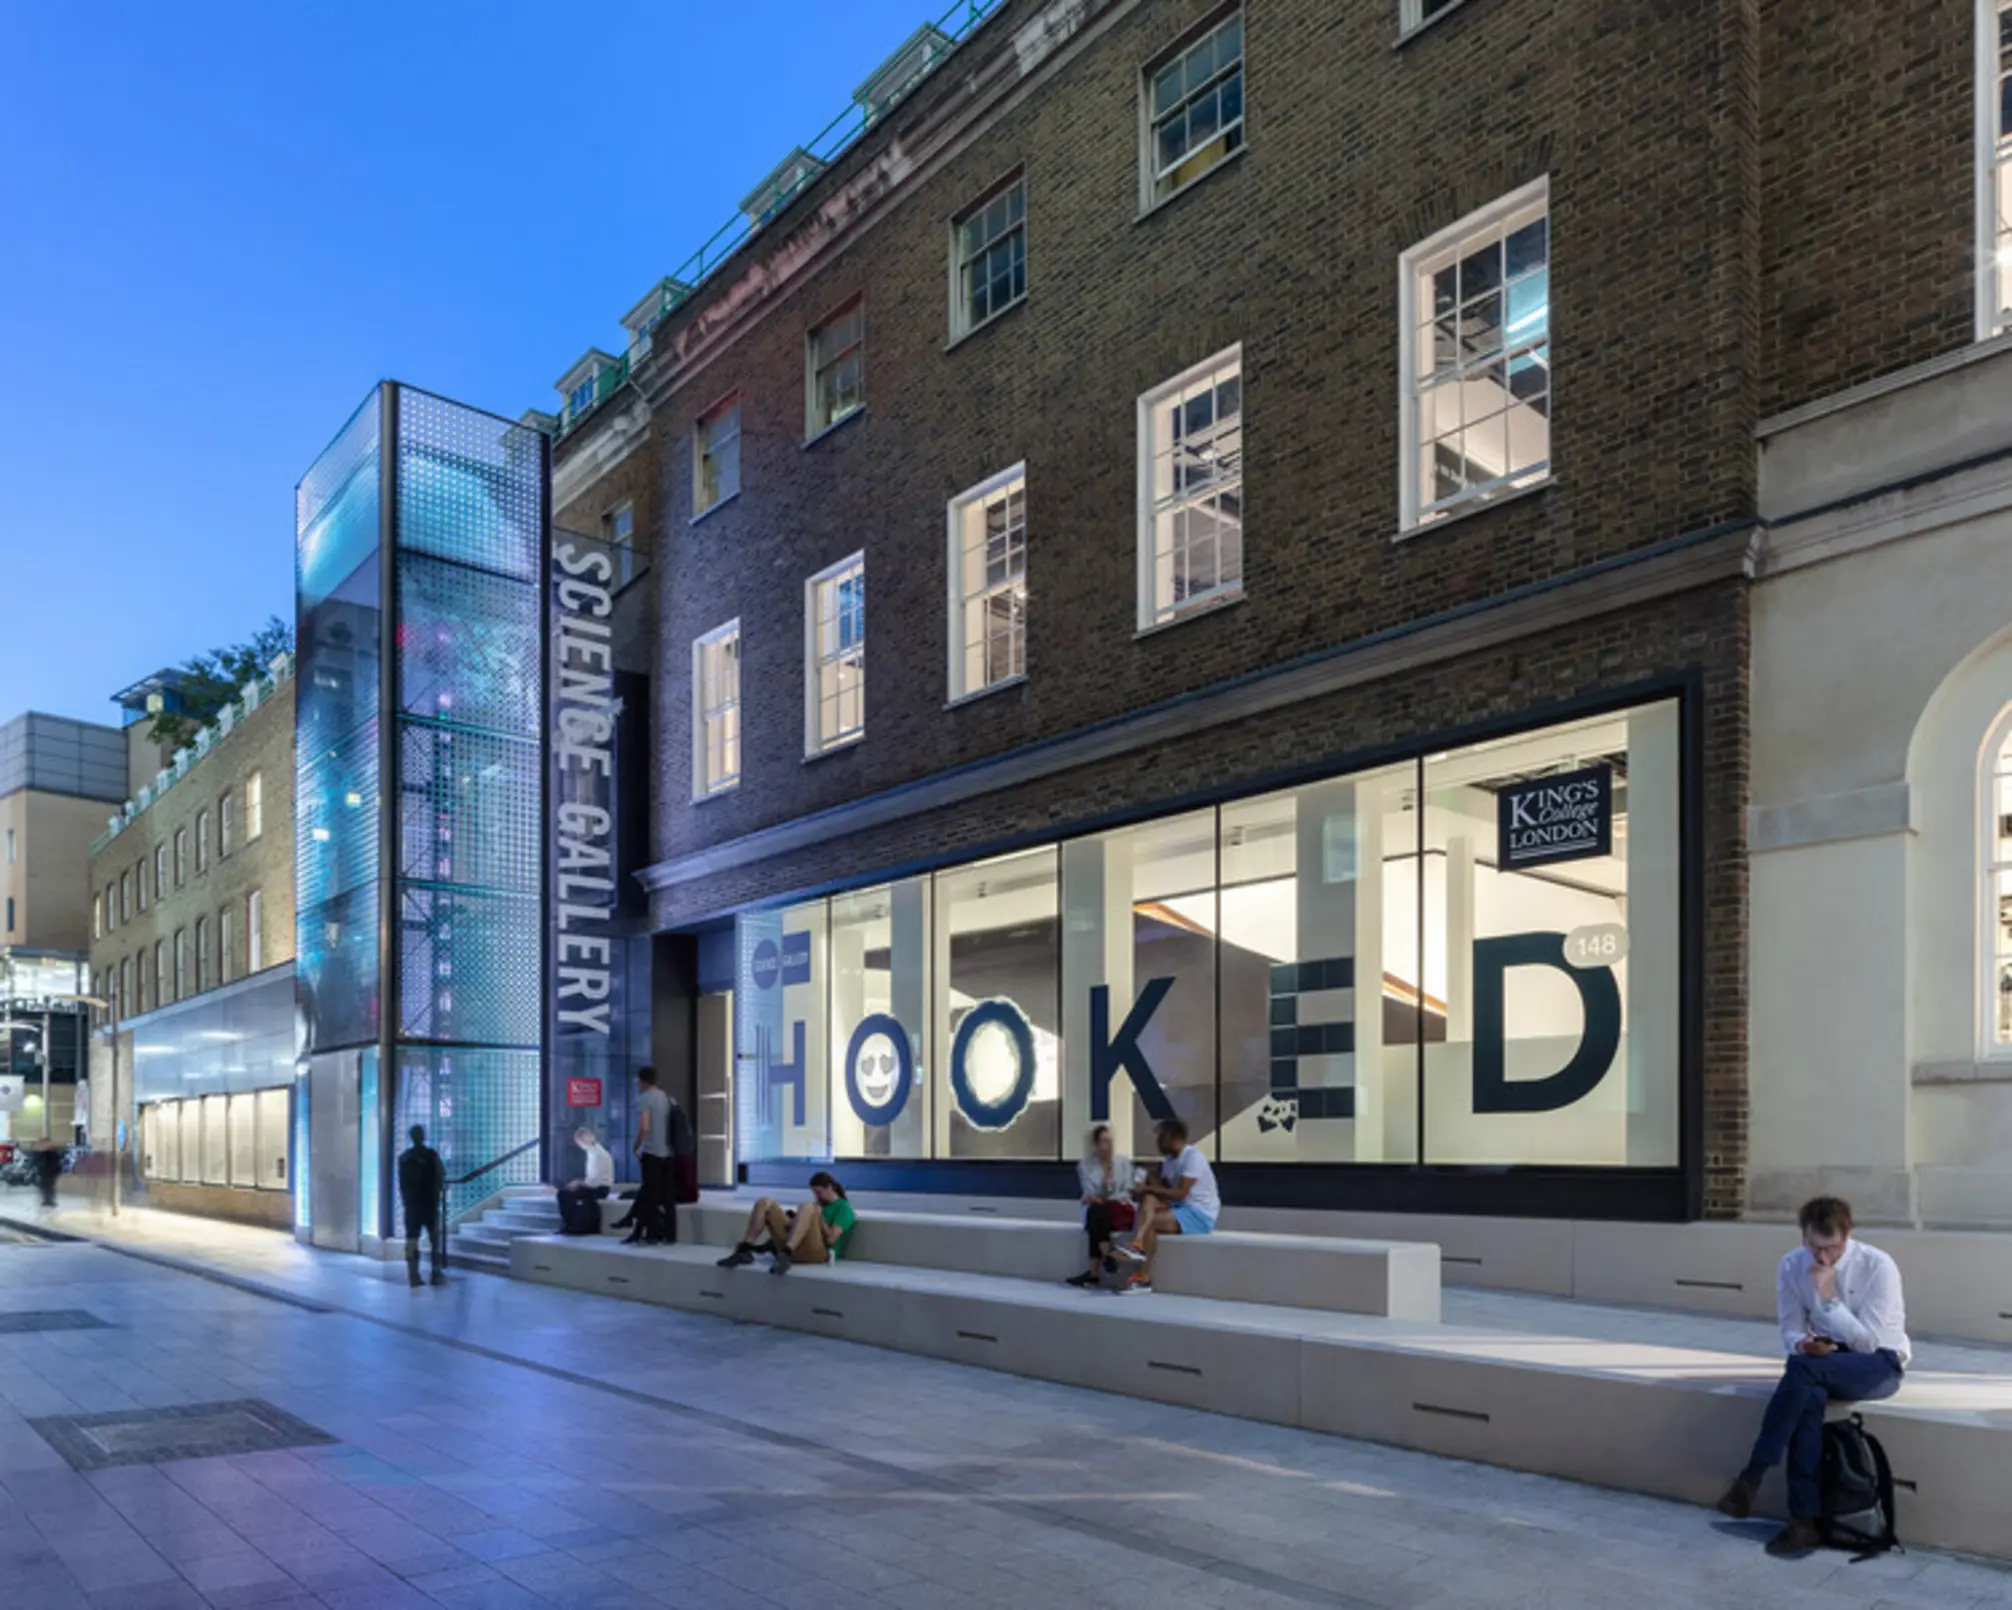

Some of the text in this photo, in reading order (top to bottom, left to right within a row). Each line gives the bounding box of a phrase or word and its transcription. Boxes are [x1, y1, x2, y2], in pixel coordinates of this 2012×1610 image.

[557, 543, 612, 776] SCIENCE
[1509, 778, 1599, 829] KING'S
[1539, 802, 1599, 824] College
[1510, 818, 1598, 848] LONDON
[558, 802, 613, 1034] GALLERY
[1575, 932, 1616, 956] 148
